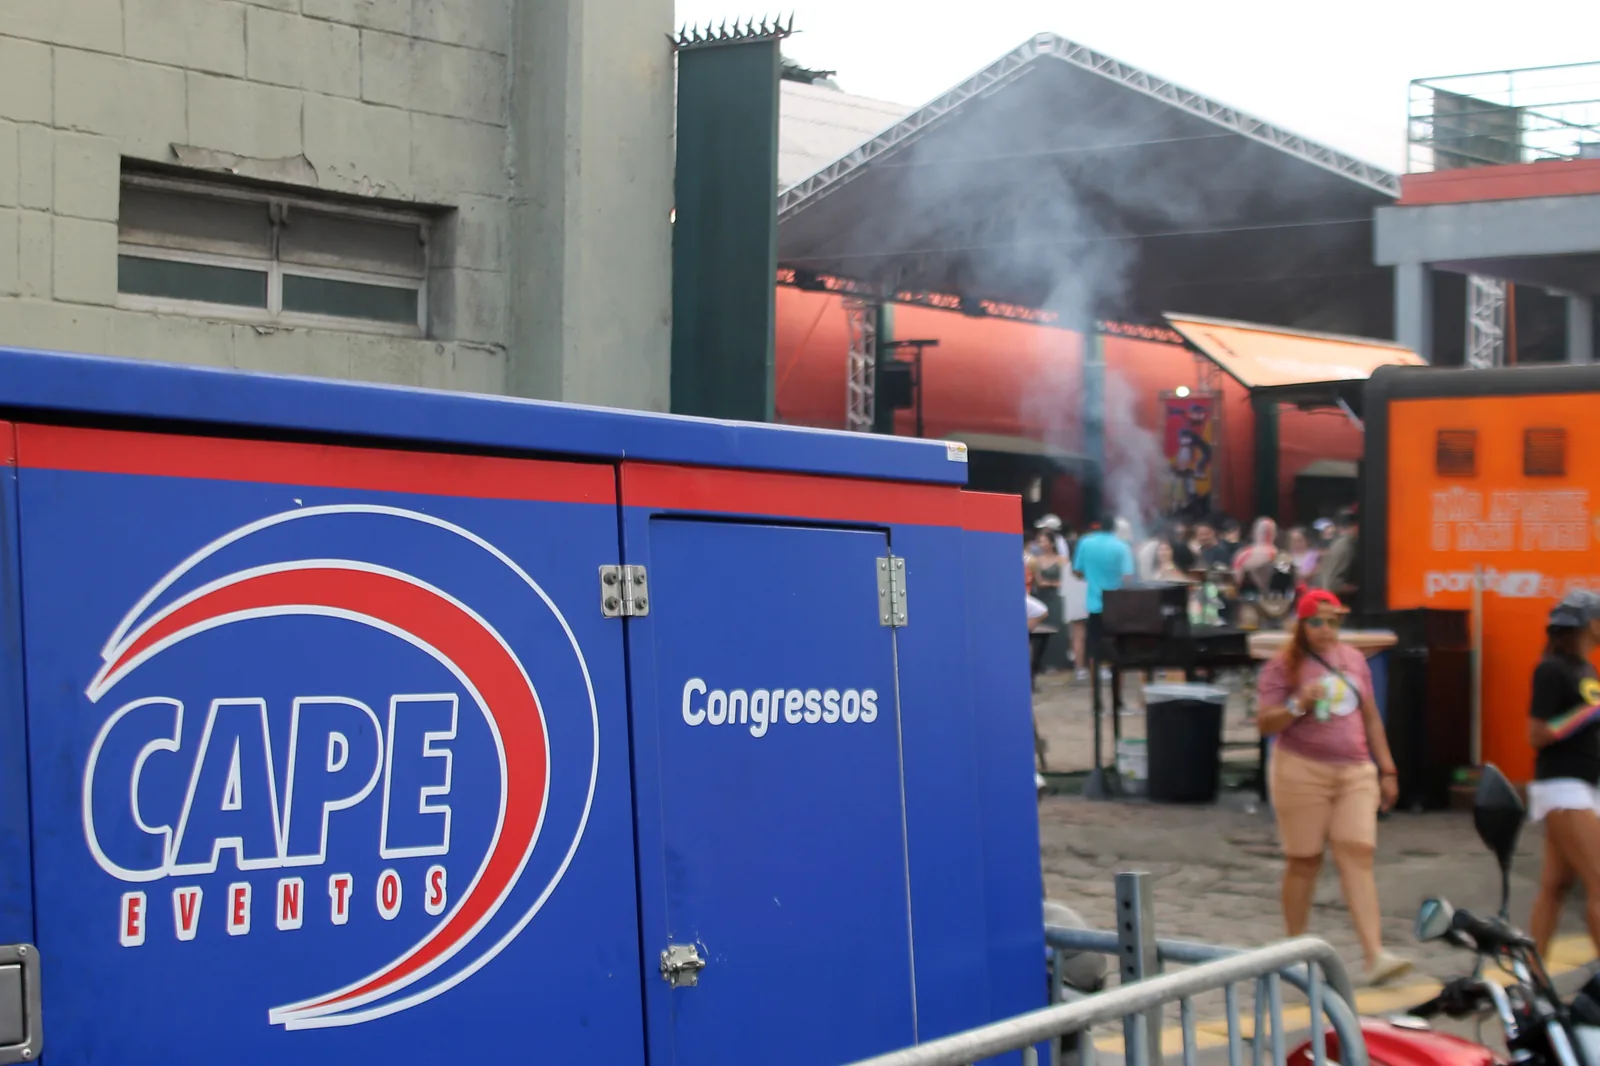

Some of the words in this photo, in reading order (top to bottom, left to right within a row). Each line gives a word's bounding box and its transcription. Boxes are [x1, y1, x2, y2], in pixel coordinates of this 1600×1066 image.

[682, 677, 878, 738] Congressos
[83, 693, 458, 882] CAPE
[119, 864, 447, 947] EVENTOS
